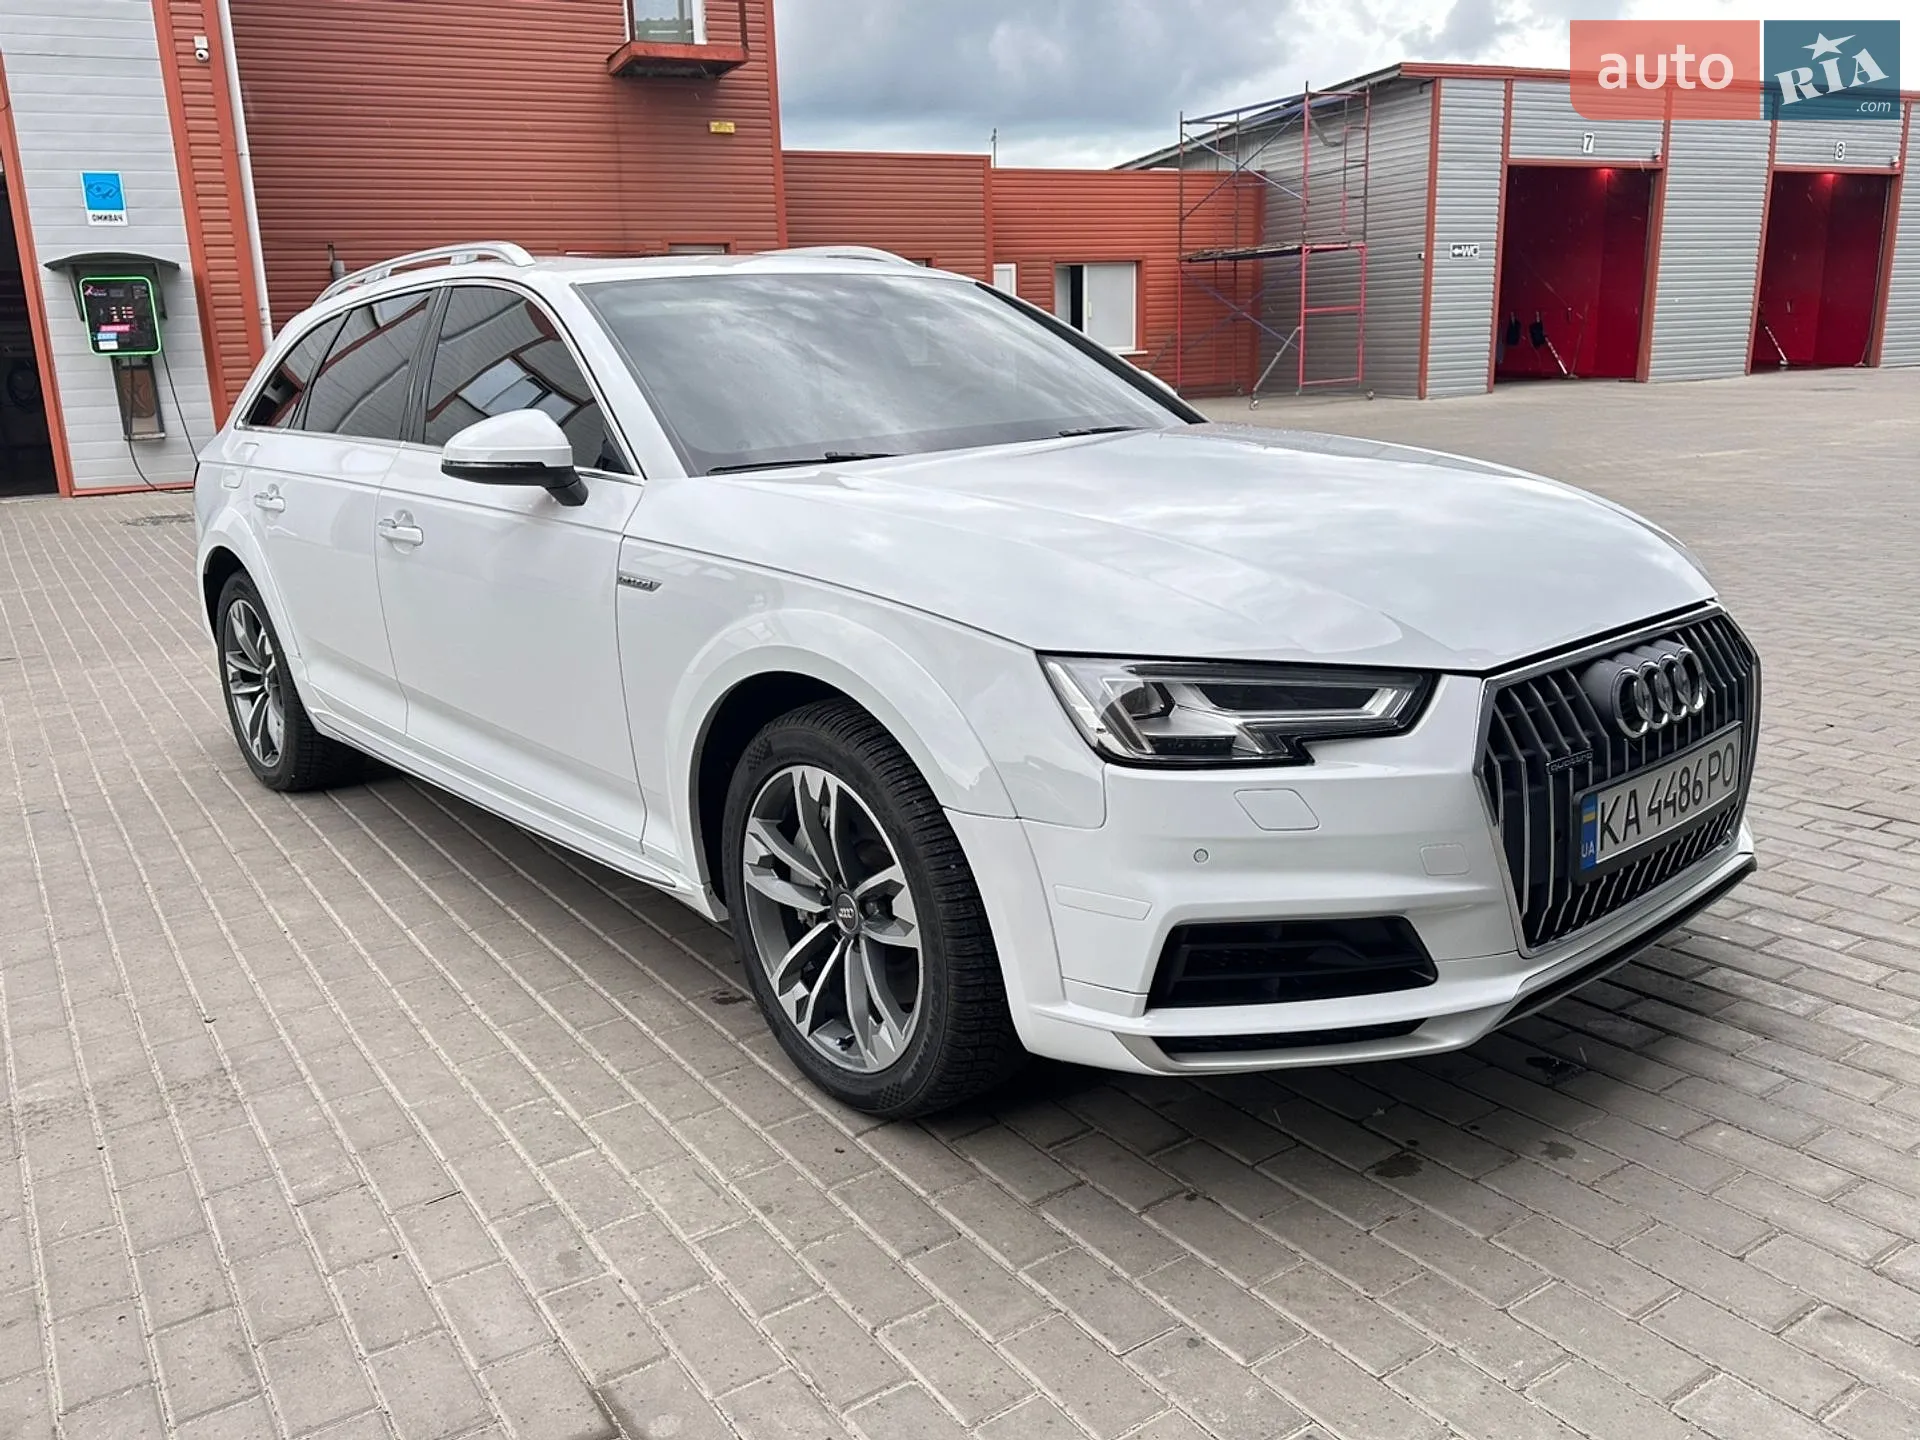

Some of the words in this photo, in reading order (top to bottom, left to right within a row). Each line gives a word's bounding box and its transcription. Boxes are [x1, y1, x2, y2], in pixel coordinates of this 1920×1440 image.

[1585, 134, 1593, 151] 7
[1837, 142, 1844, 159] 8
[1600, 788, 1642, 851] KA
[1646, 758, 1704, 826] 4486
[1707, 742, 1736, 799] PO
[1581, 843, 1595, 858] UA
